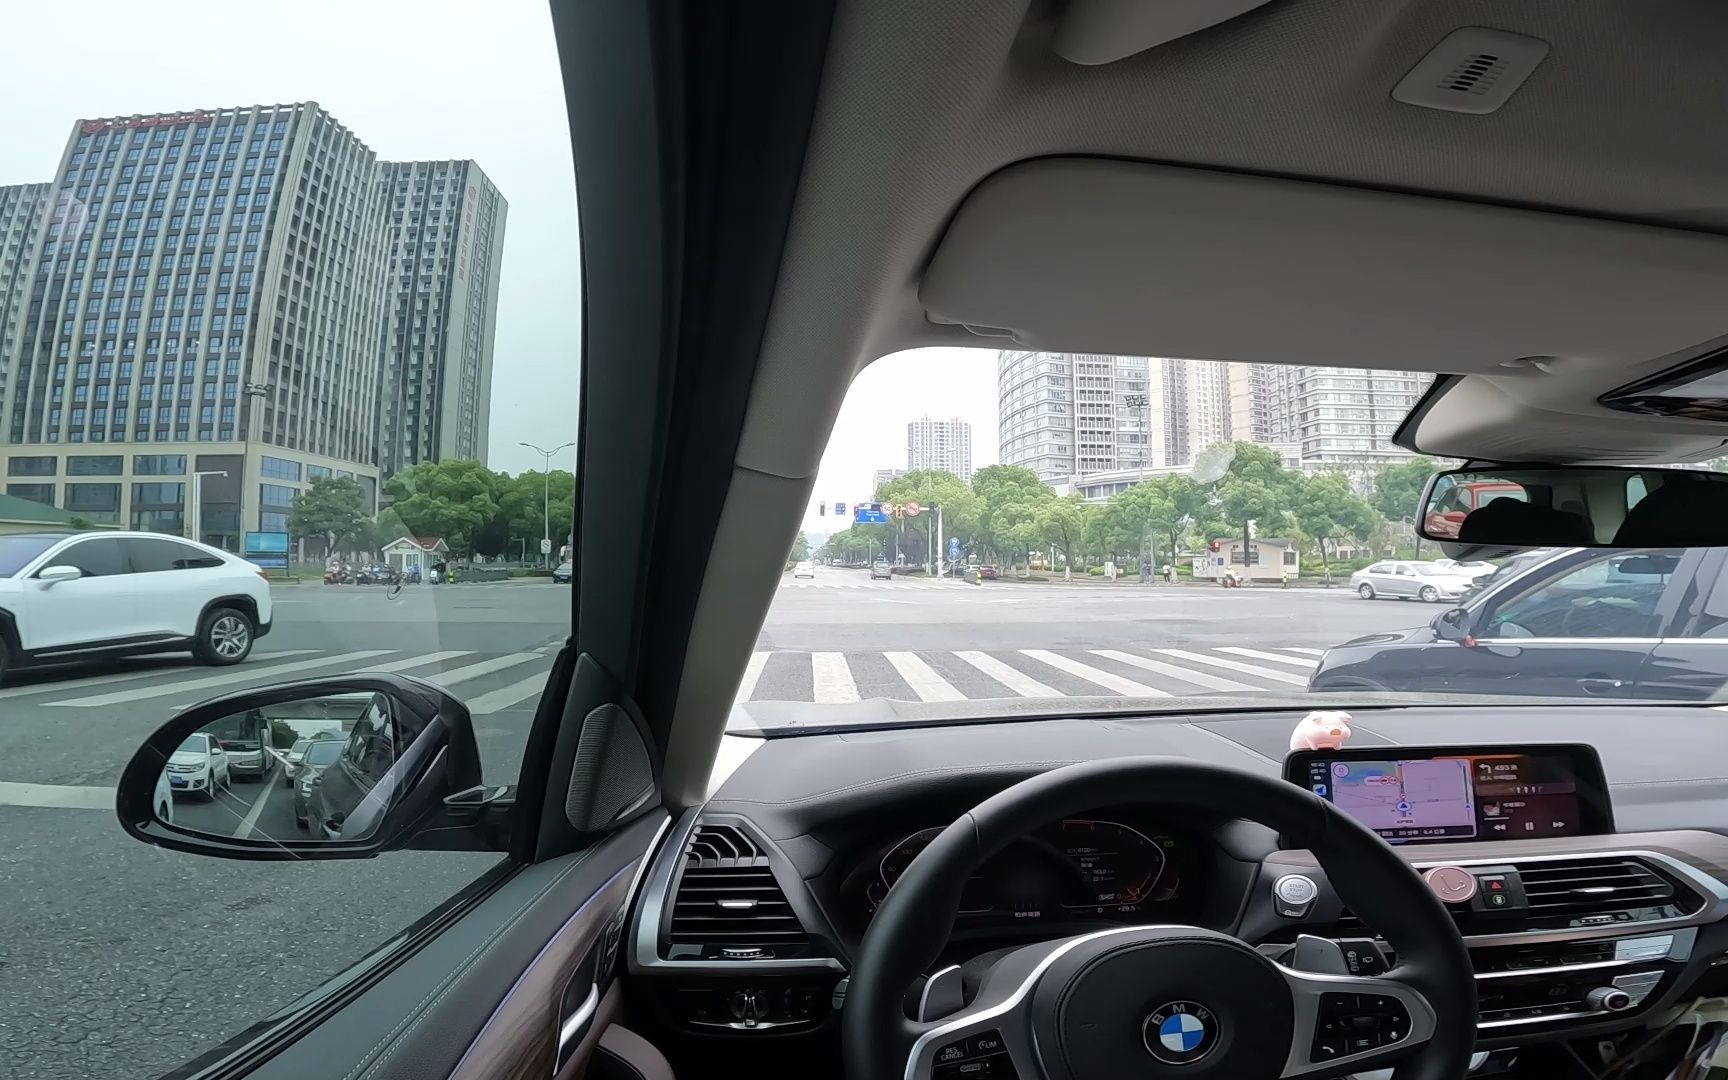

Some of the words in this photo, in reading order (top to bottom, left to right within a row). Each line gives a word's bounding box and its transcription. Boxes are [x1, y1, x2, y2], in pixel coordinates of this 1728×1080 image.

[1151, 1004, 1210, 1025] BMW
[985, 1040, 997, 1048] LIM
[945, 1046, 958, 1055] RES
[940, 1052, 964, 1061] CANCEL
